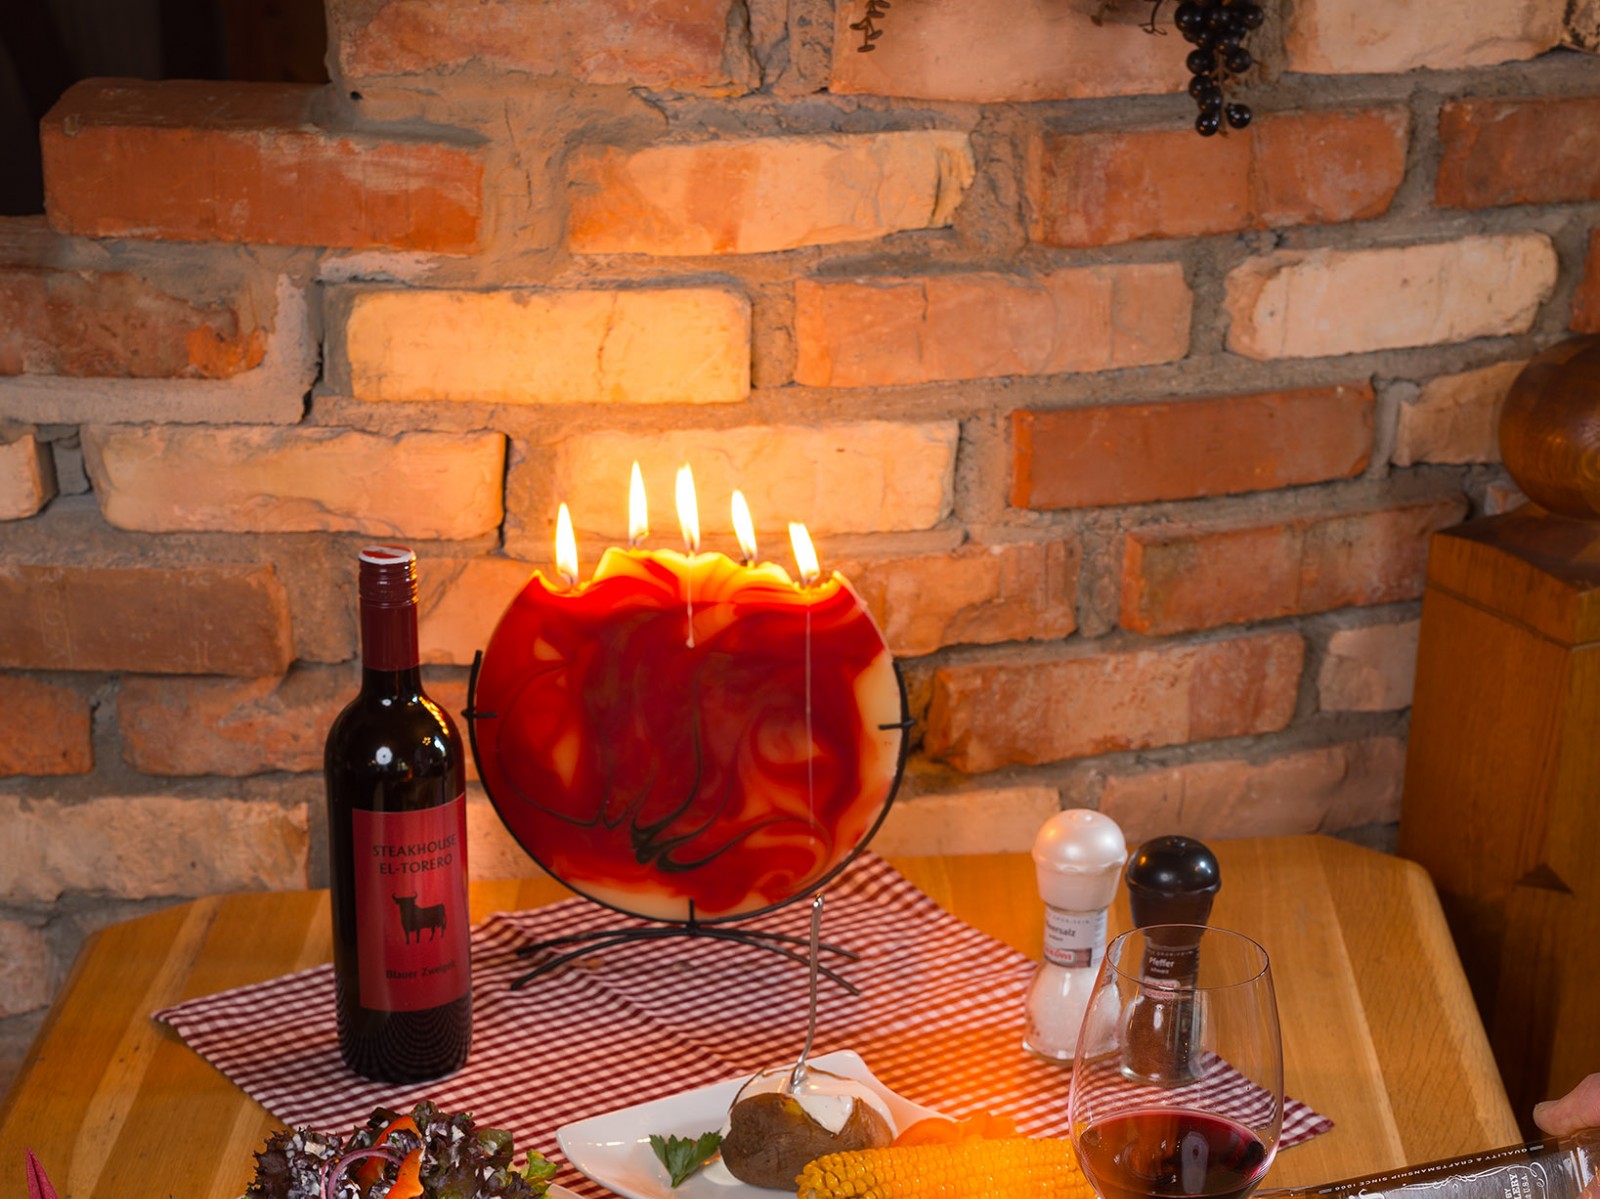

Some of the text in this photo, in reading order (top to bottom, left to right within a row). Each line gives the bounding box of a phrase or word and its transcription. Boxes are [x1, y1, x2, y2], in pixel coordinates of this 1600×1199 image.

[372, 834, 456, 857] STEAKHOUSE
[379, 853, 453, 875] EL-TORERO
[1484, 1147, 1528, 1161] QUALITY
[1391, 1159, 1473, 1180] CRAFTSMANSHIP
[1359, 1176, 1388, 1187] SINCE
[1504, 1188, 1513, 1199] BY
